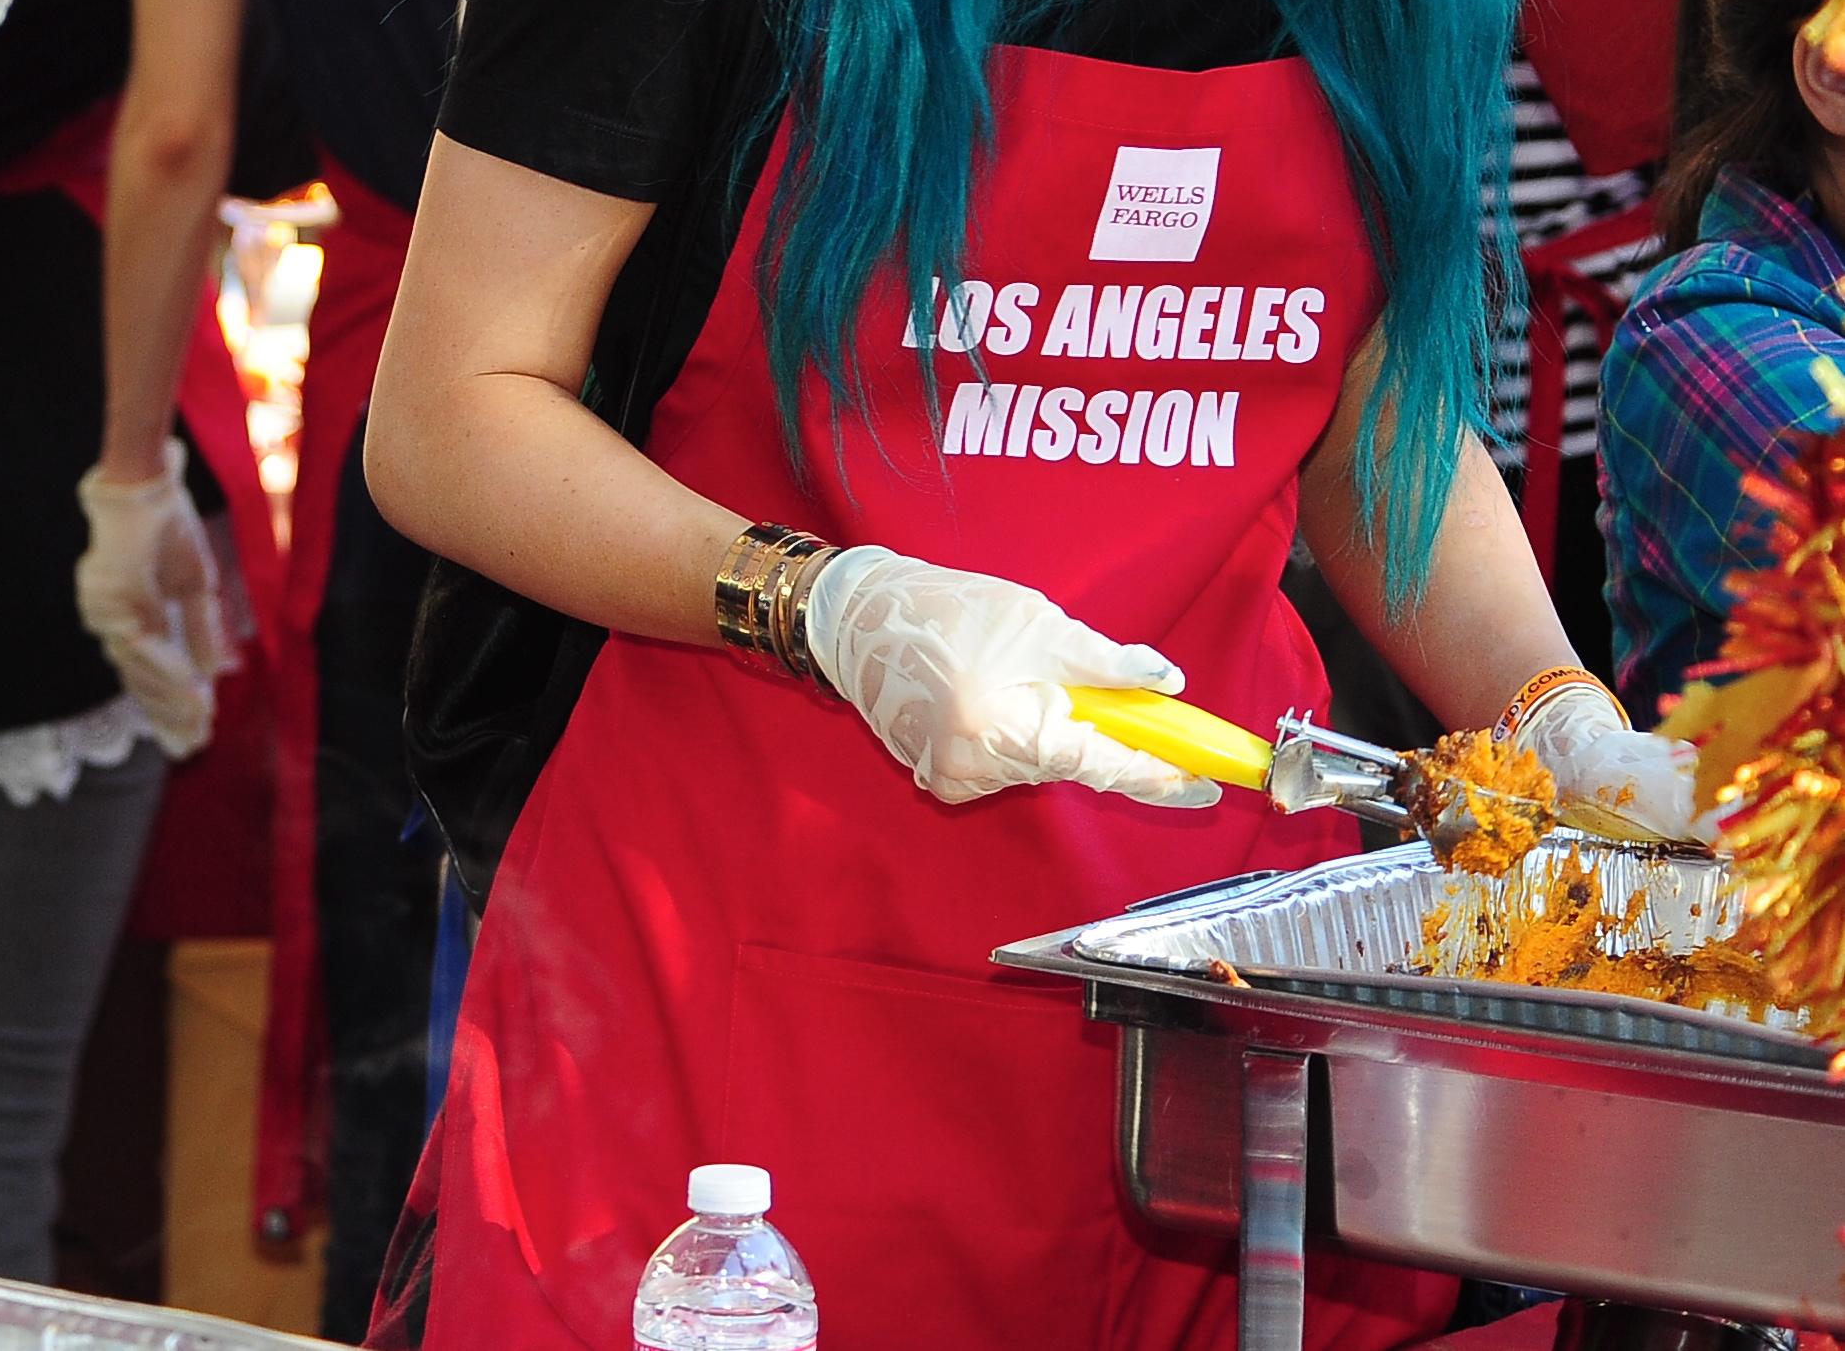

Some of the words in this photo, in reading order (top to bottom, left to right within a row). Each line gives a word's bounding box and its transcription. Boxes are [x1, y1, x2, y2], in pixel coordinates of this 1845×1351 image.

[1110, 208, 1198, 229] FARGO
[1116, 184, 1205, 204] WELLS
[1041, 284, 1325, 364] ANGELES
[941, 382, 1240, 468] MISSION
